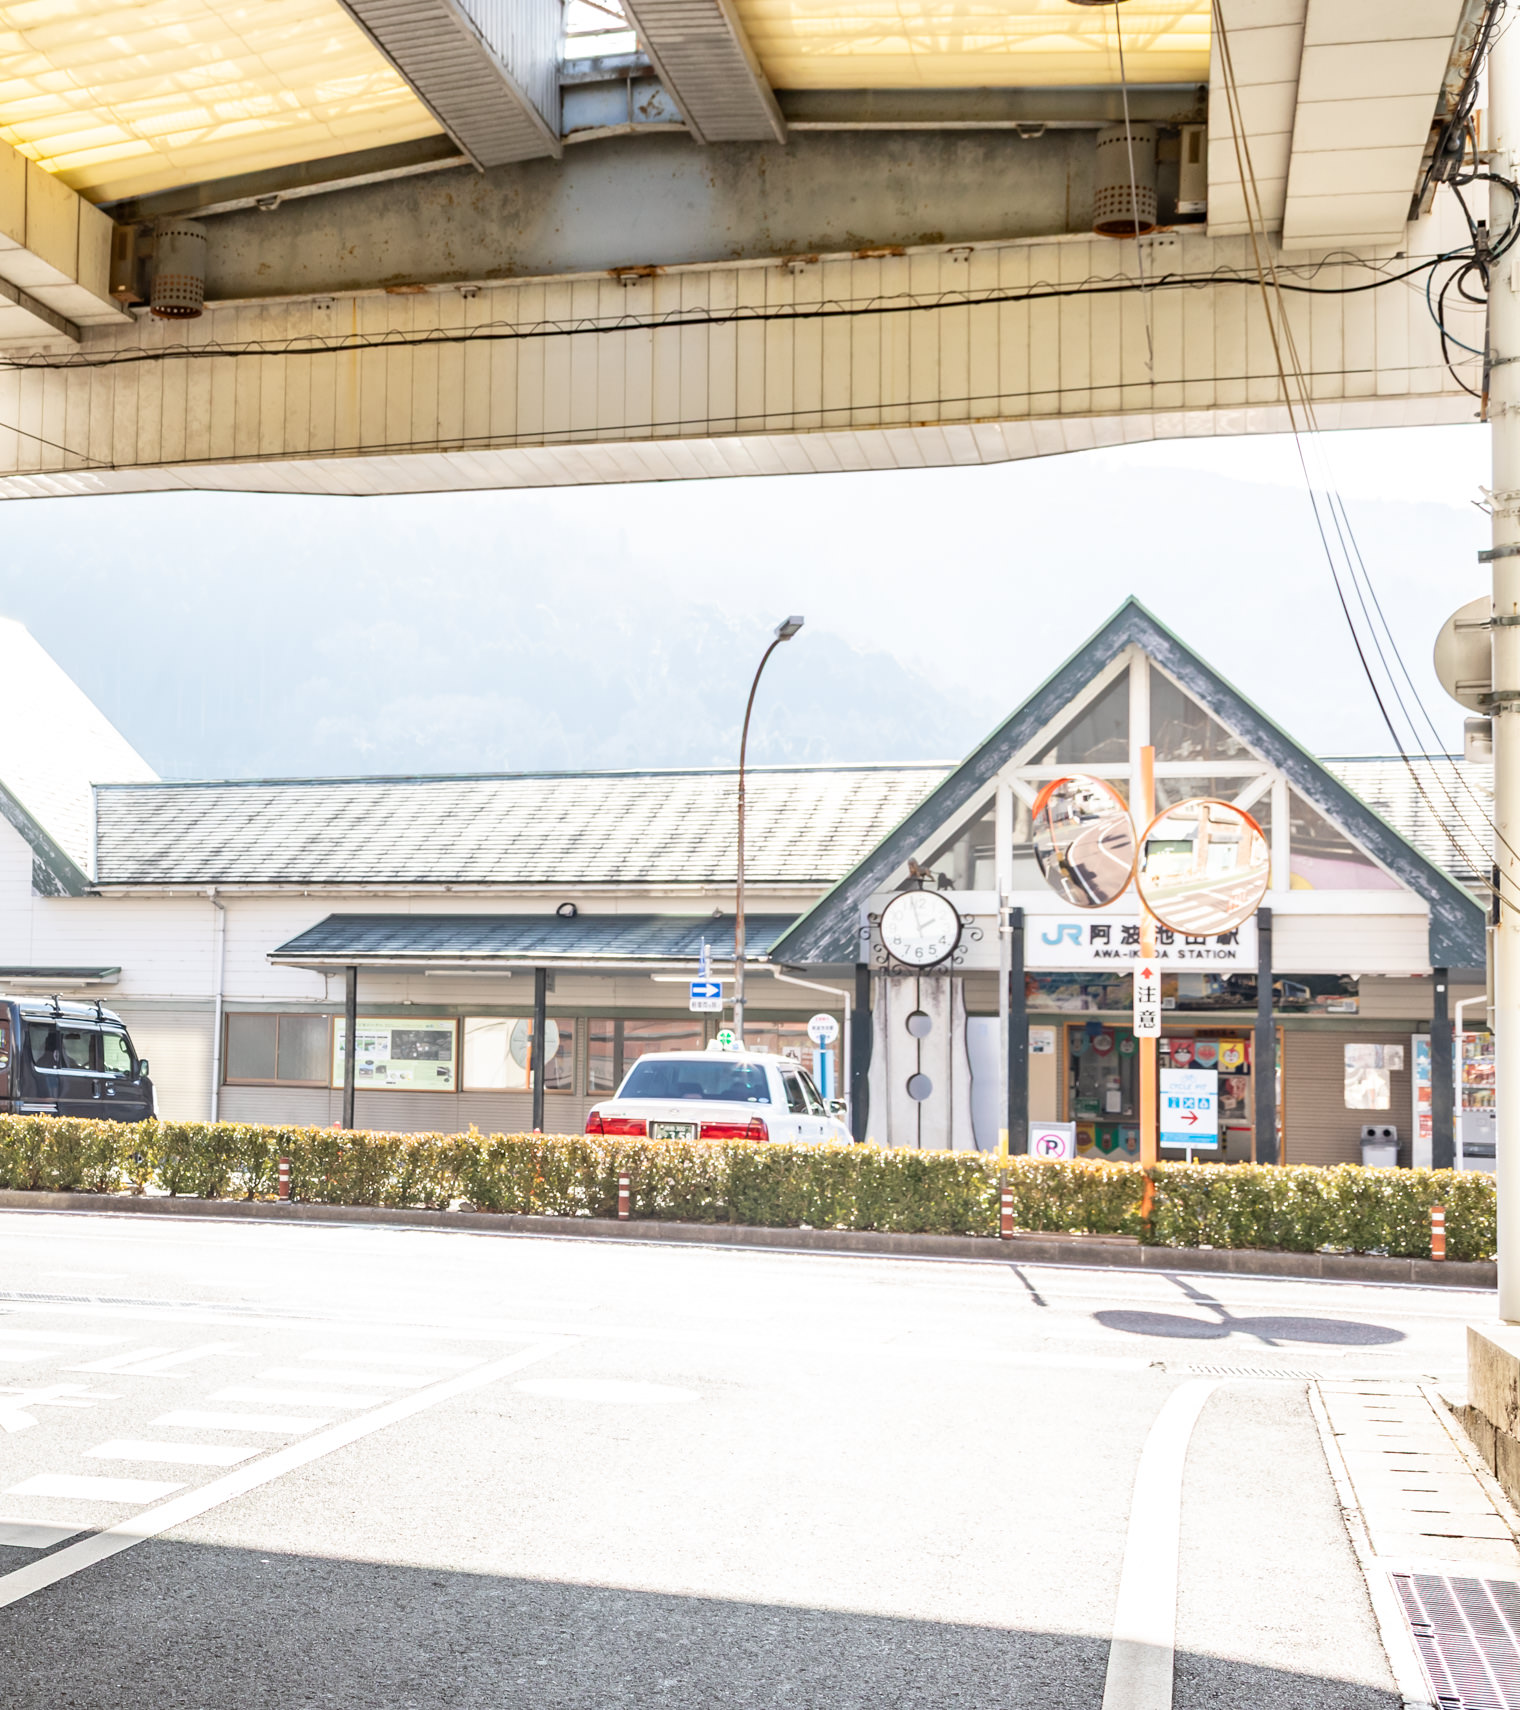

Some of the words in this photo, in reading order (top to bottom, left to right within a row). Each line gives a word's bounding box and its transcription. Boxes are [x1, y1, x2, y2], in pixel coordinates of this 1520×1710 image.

[1042, 924, 1083, 945] JR
[915, 947, 924, 958] 6
[1178, 950, 1237, 959] STATION
[1138, 985, 1157, 1029] 注意
